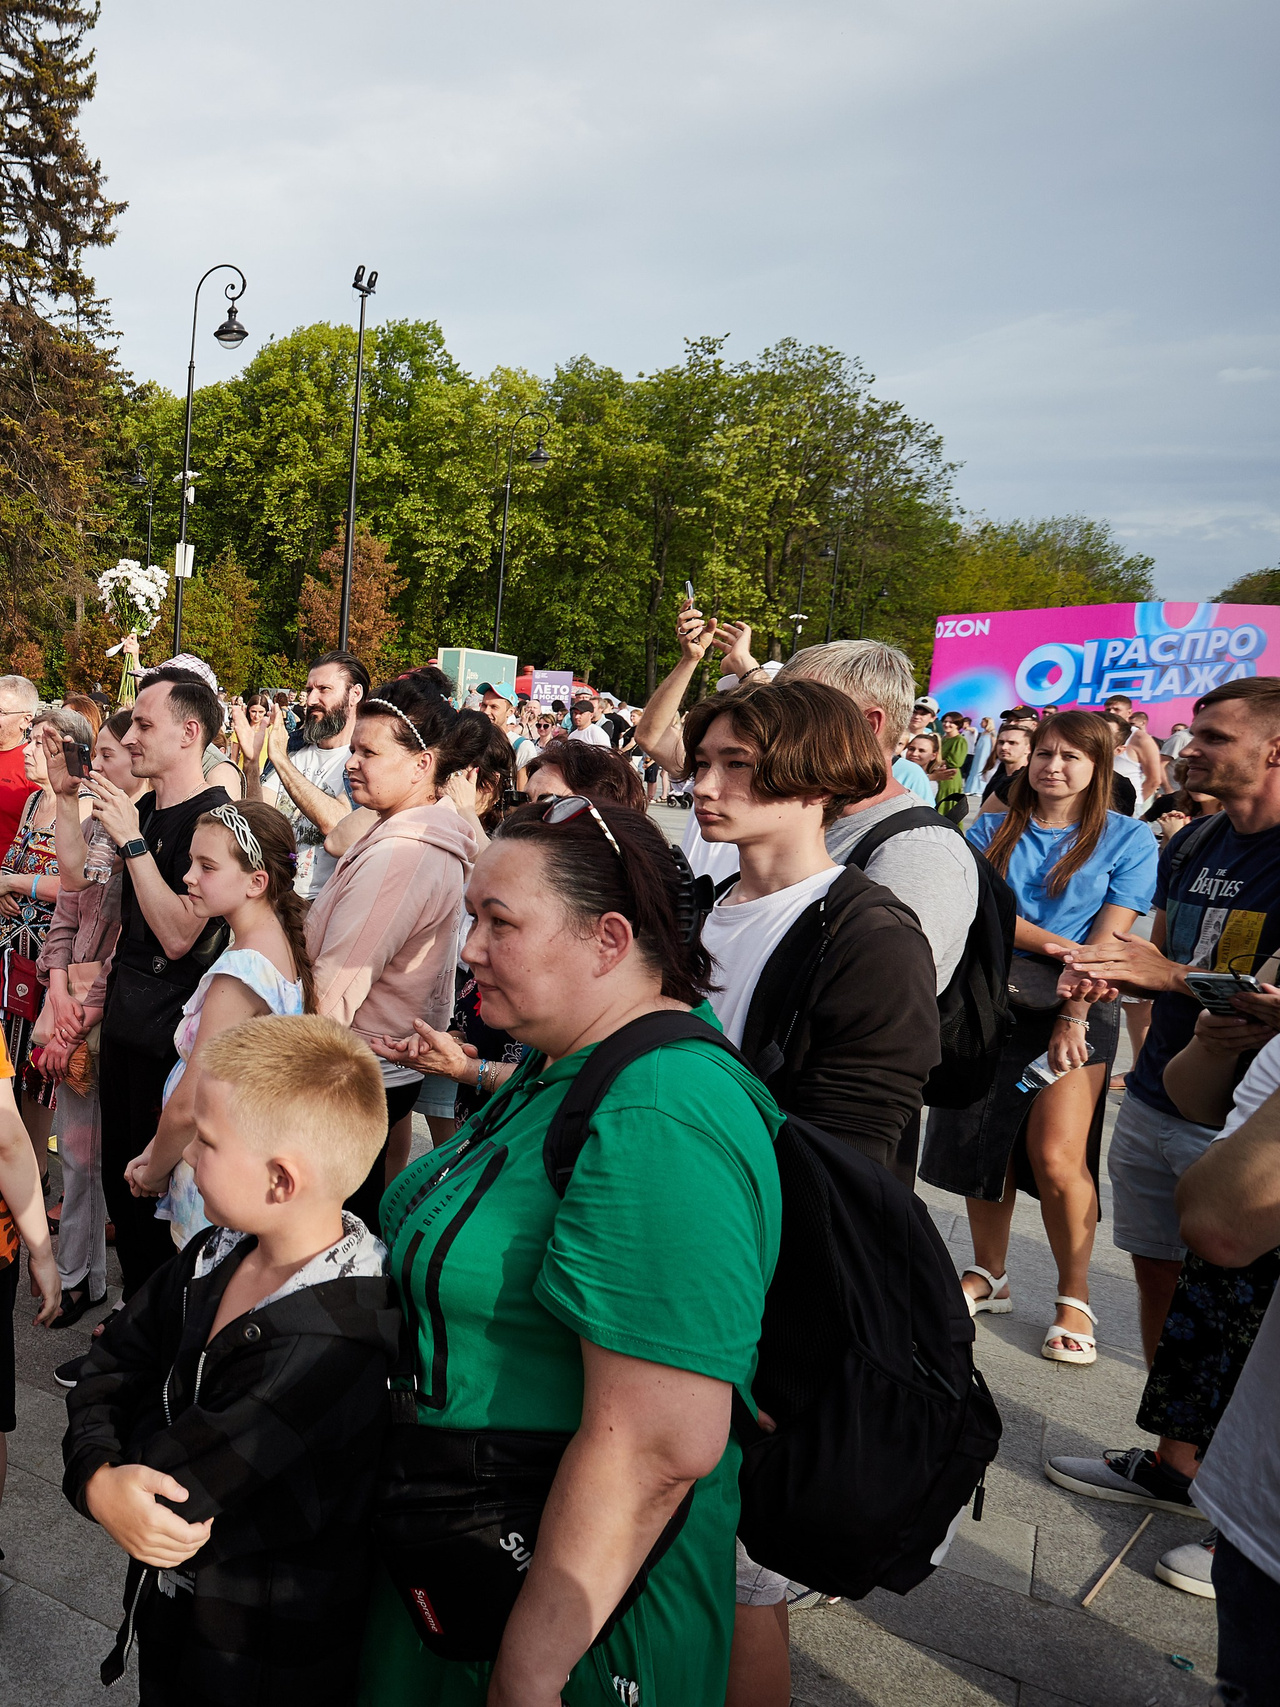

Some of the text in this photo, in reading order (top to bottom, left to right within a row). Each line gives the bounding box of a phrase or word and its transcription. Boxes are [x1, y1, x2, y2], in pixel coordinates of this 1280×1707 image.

[935, 618, 991, 639] OZON
[1102, 625, 1259, 668] РАСПРО
[533, 684, 570, 695] ЛЕТО
[1188, 867, 1244, 900] BEATLES
[1215, 868, 1228, 877] THE
[422, 1193, 453, 1227] GINZA
[499, 1532, 535, 1572] Su
[414, 1588, 438, 1633] Supreme
